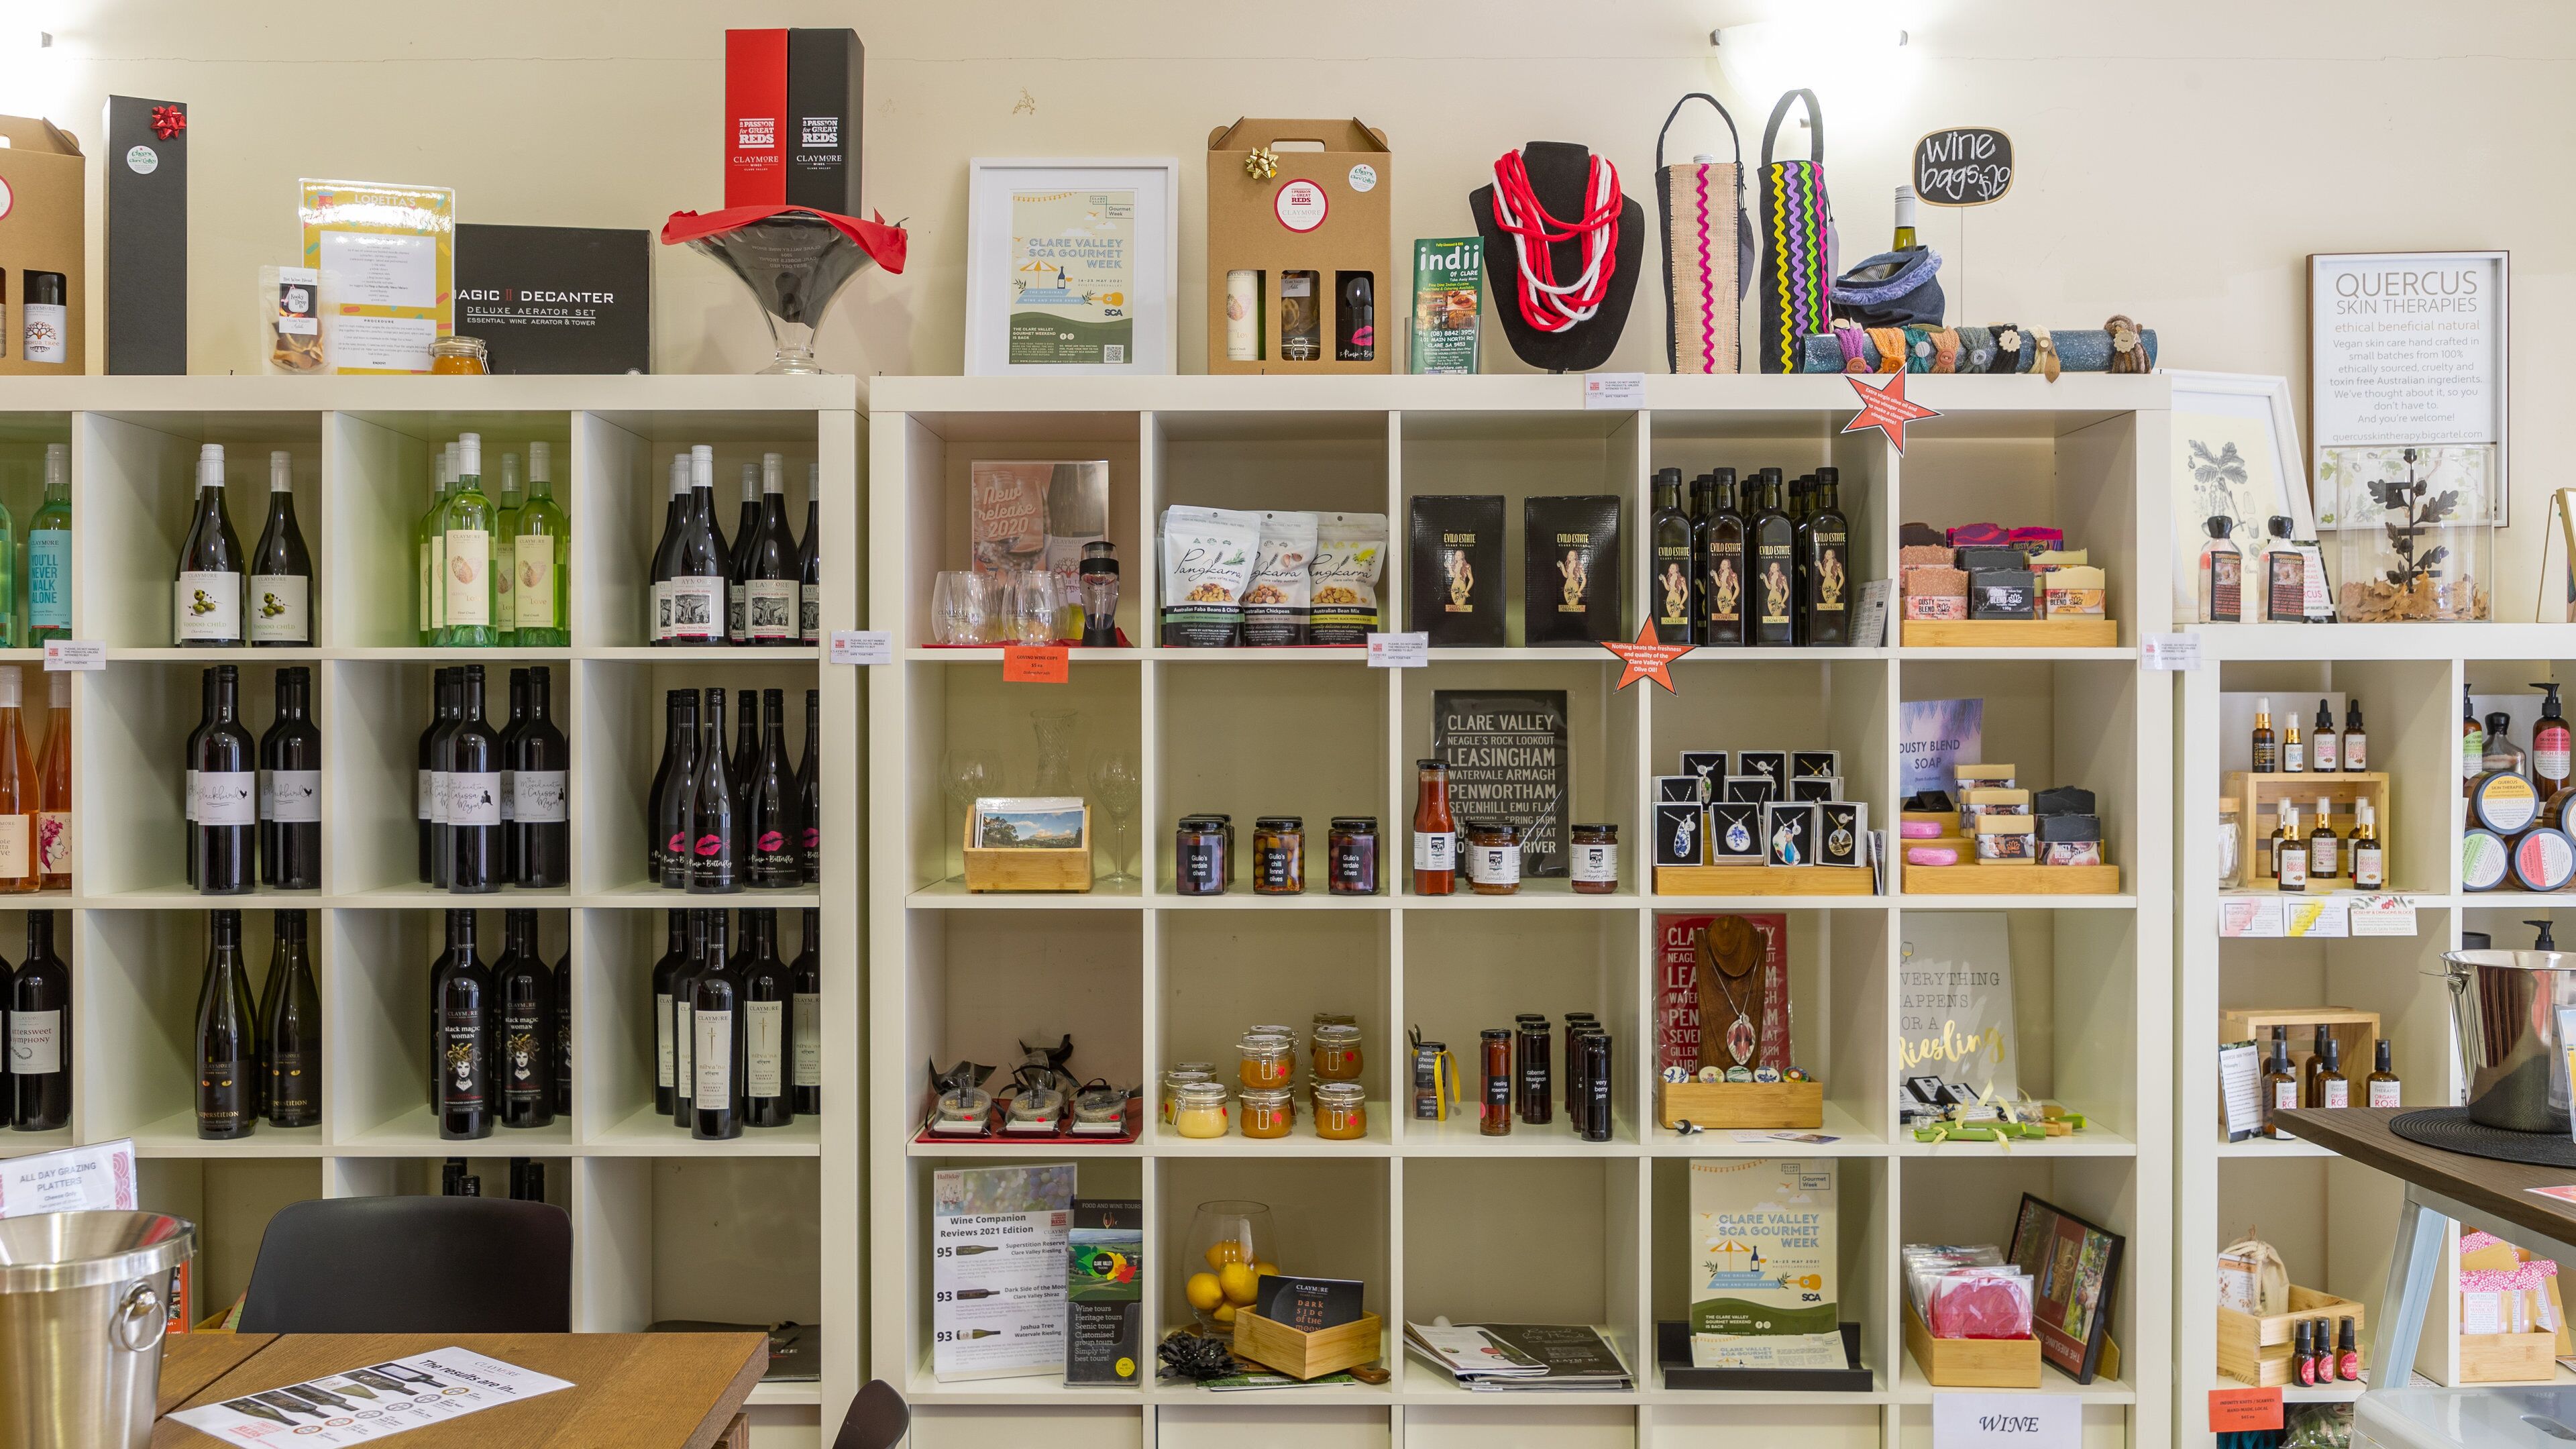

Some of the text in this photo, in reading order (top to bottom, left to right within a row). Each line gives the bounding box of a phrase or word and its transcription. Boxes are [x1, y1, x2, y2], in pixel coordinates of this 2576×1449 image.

[739, 134, 774, 144] REDS
[802, 133, 837, 143] REDS
[1921, 154, 1980, 200] bags
[1029, 238, 1123, 248] CLARE VALLEY
[1029, 249, 1123, 258] SCA GOURMET
[1420, 245, 1479, 271] indii
[1087, 260, 1122, 268] WEEK
[2336, 271, 2477, 299] QUERCUS
[455, 289, 500, 301] AGIC
[521, 291, 614, 303] DECANTER
[2337, 297, 2477, 315] SKIN THERAPIES
[2335, 320, 2479, 333] ethical beneficial natural
[2333, 339, 2363, 350] Vegan
[2365, 339, 2384, 347] skin
[2409, 338, 2432, 346] hand
[2435, 337, 2468, 345] crafted
[2471, 337, 2479, 345] in
[1865, 388, 1878, 396] Extra
[1878, 392, 1890, 401] virgin
[1890, 398, 1901, 406] olive
[1874, 405, 1886, 414] make
[1890, 412, 1904, 421] classic
[1880, 400, 1897, 411] vinegar
[1897, 407, 1917, 419] combine
[1871, 412, 1896, 425] vinaigrette!
[2333, 431, 2483, 442] quercusskintherapy.bigcartel.com
[983, 486, 1022, 505] New
[978, 504, 1036, 521] release
[987, 517, 1029, 537] 2020
[1444, 534, 1476, 543] EVILO ESTATE
[1760, 545, 1790, 555] EVILO ESTATE
[32, 554, 58, 566] YOU'LL
[1174, 548, 1242, 582] Pangkarra
[32, 567, 57, 578] NEVER
[32, 580, 55, 591] WALK
[32, 592, 57, 603] ALONE
[1448, 714, 1554, 731] CLARE VALLEY
[1448, 736, 1554, 745] NEAGLE'S ROCK LOOKOUT
[1930, 739, 1960, 751] BLEND
[1448, 748, 1556, 767] LEASINGHAM
[1915, 757, 1941, 769] SOAP
[1448, 769, 1556, 781] WATERVALE ARMAGH
[1448, 784, 1556, 799] PENWORTHAM
[1450, 802, 1556, 814] SEVENHILL EMU FLAT
[1900, 973, 2000, 985] VERYTHING
[19, 1162, 97, 1183] ALL DAY GRAZING
[37, 1177, 82, 1191] PLATTERS
[950, 1214, 1026, 1225] Wine Companion
[941, 1229, 978, 1238] Reviews
[1002, 1226, 1034, 1234] Edition
[936, 1247, 953, 1257] 95
[936, 1292, 953, 1302] 93
[936, 1332, 953, 1341] 93
[419, 1360, 442, 1368] The
[439, 1367, 480, 1381] results
[477, 1379, 500, 1387] are
[1980, 1414, 2039, 1432] WINE
